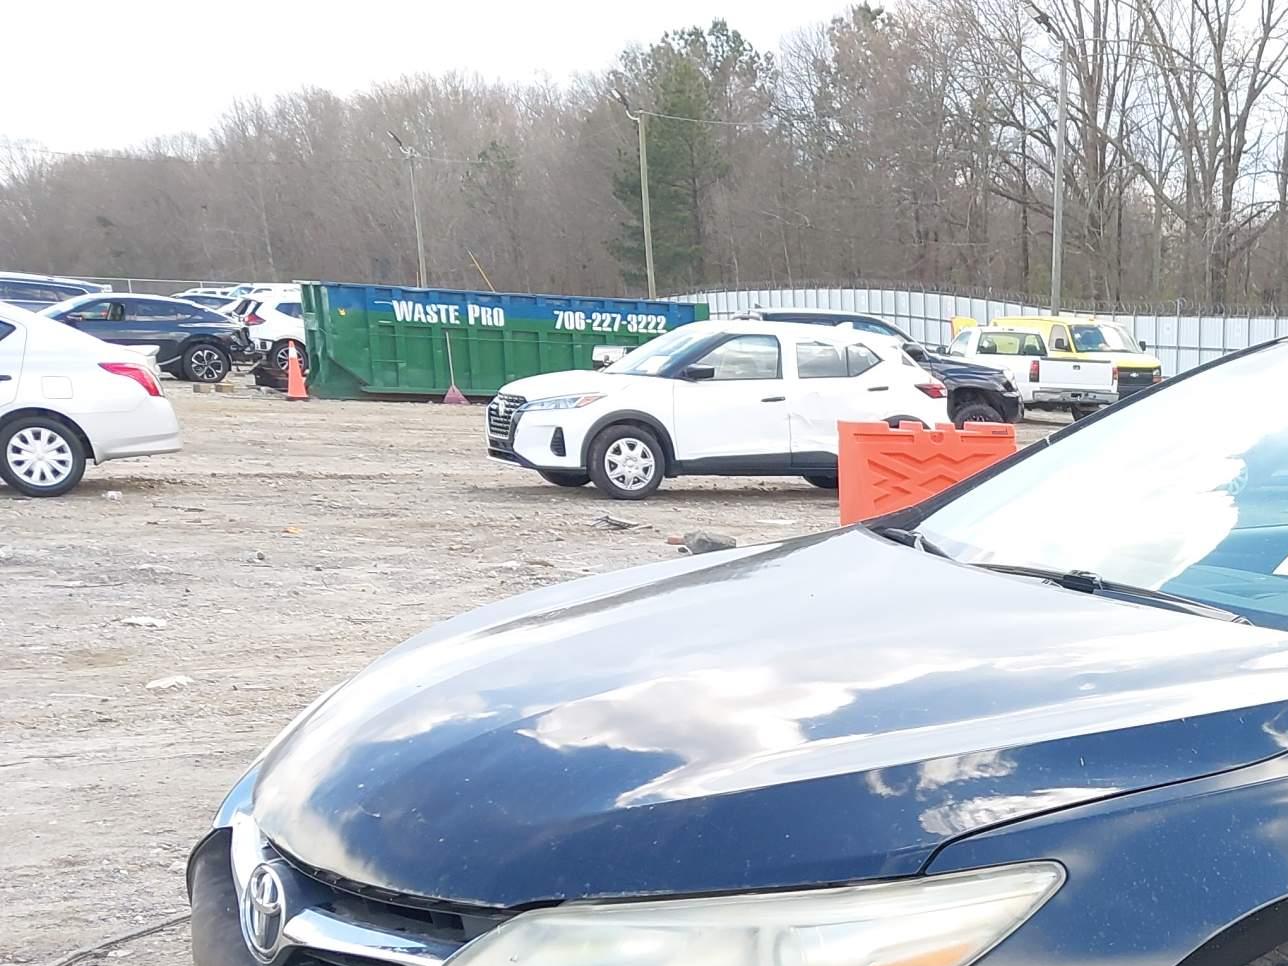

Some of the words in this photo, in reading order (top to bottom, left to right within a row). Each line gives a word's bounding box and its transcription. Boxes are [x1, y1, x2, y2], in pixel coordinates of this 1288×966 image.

[392, 300, 460, 325] WASTE
[468, 304, 505, 327] PRO
[554, 311, 667, 334] 706-227-3222
